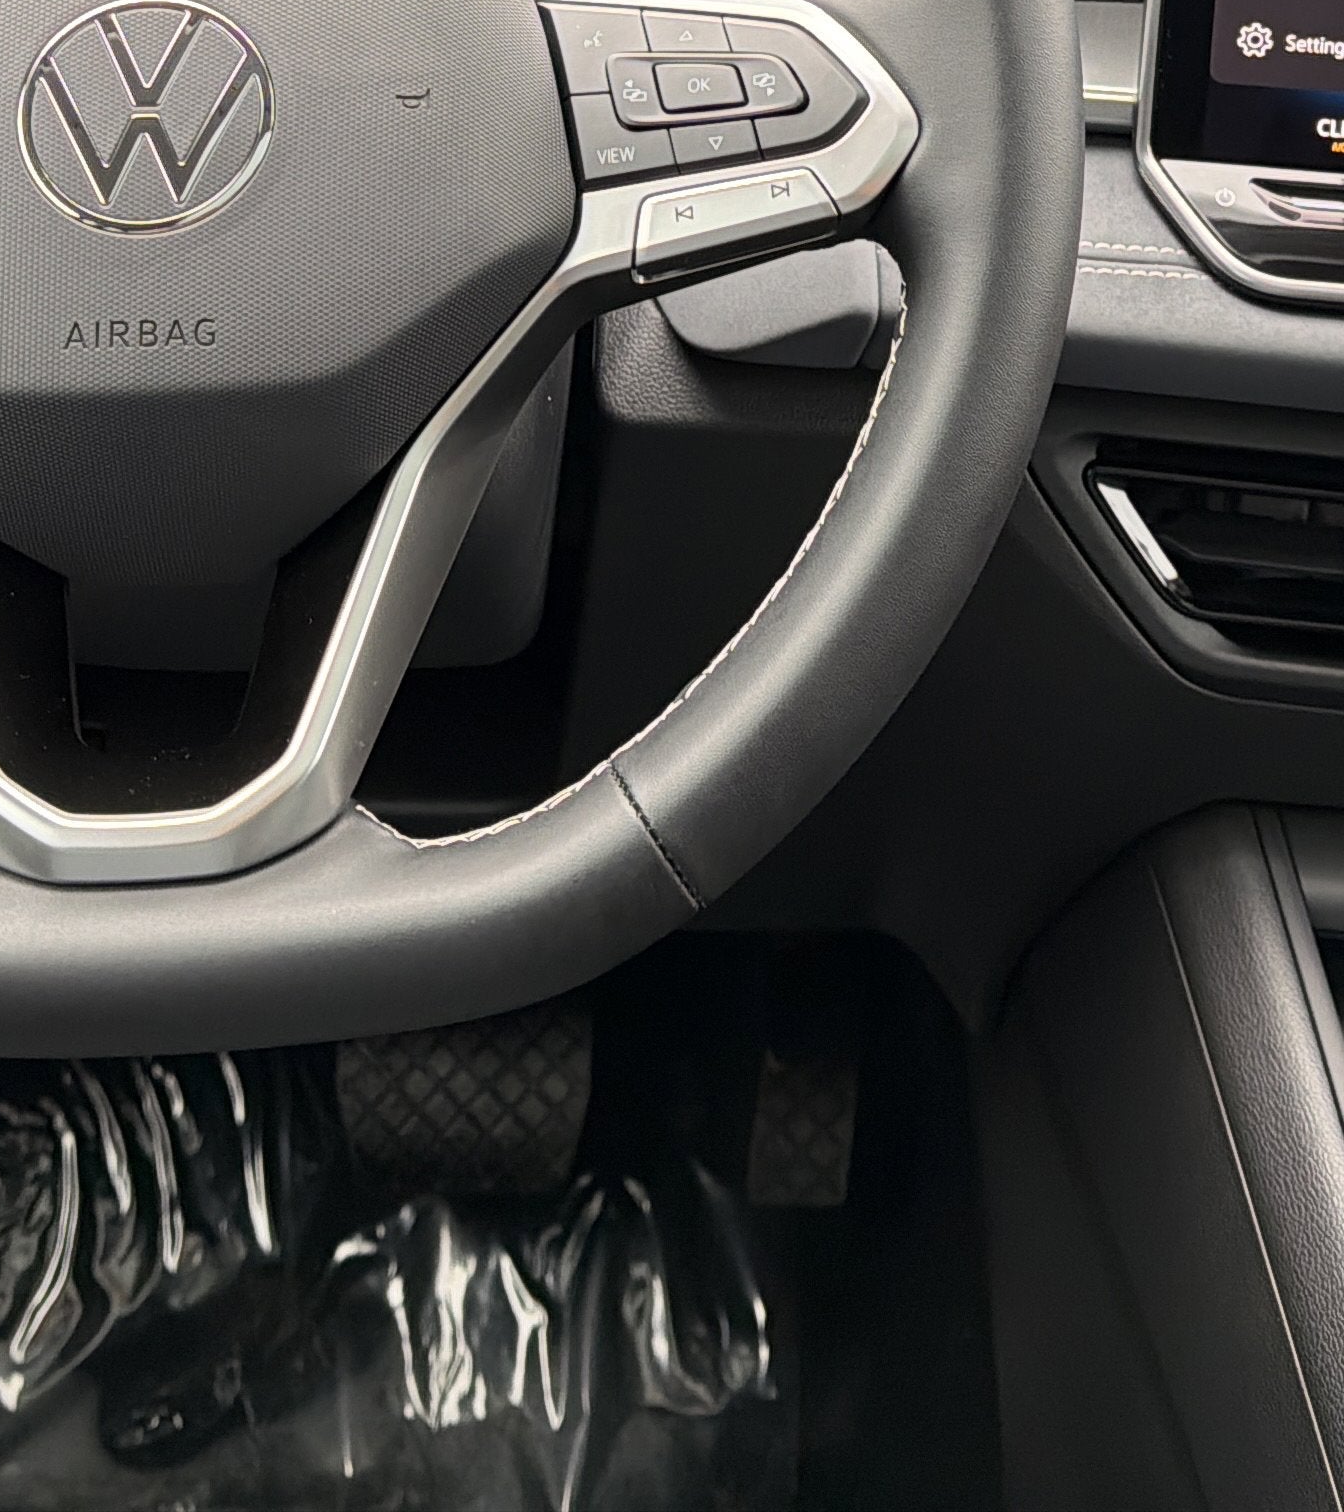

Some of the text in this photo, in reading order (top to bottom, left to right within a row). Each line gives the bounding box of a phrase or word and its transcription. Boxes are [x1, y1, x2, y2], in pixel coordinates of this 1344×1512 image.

[686, 77, 711, 93] OK
[596, 146, 636, 165] VIEW
[63, 318, 218, 351] AIRBAG
